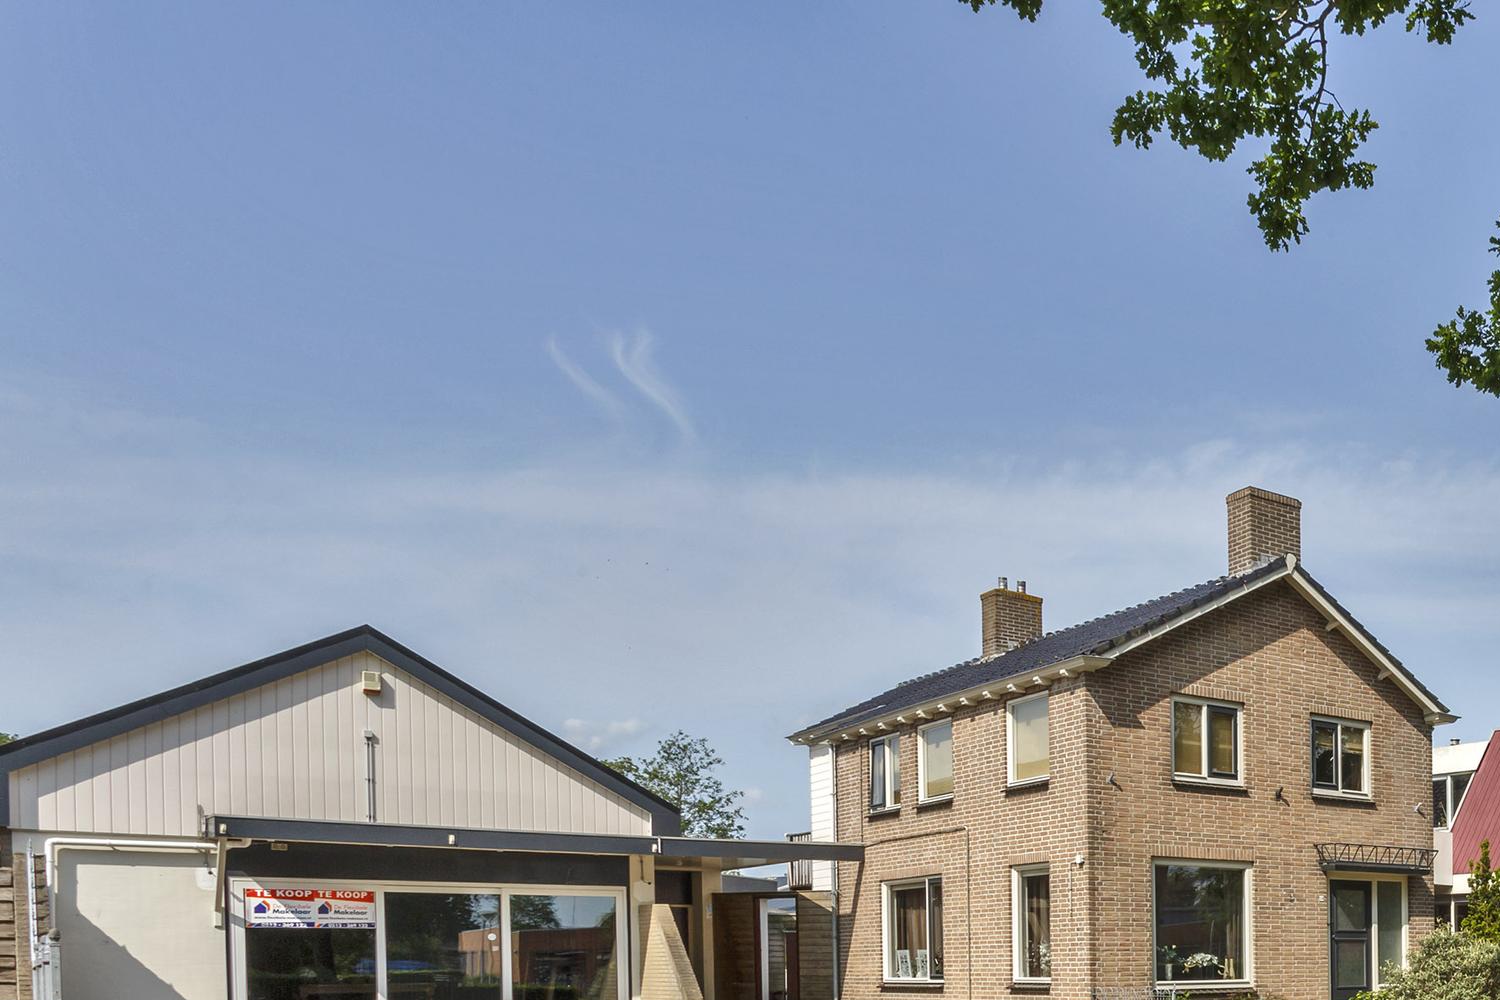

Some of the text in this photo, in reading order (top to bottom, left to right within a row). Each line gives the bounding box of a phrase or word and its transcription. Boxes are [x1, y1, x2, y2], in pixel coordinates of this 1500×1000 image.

[254, 889, 312, 898] TE KOOP
[317, 890, 368, 899] TE KOOP
